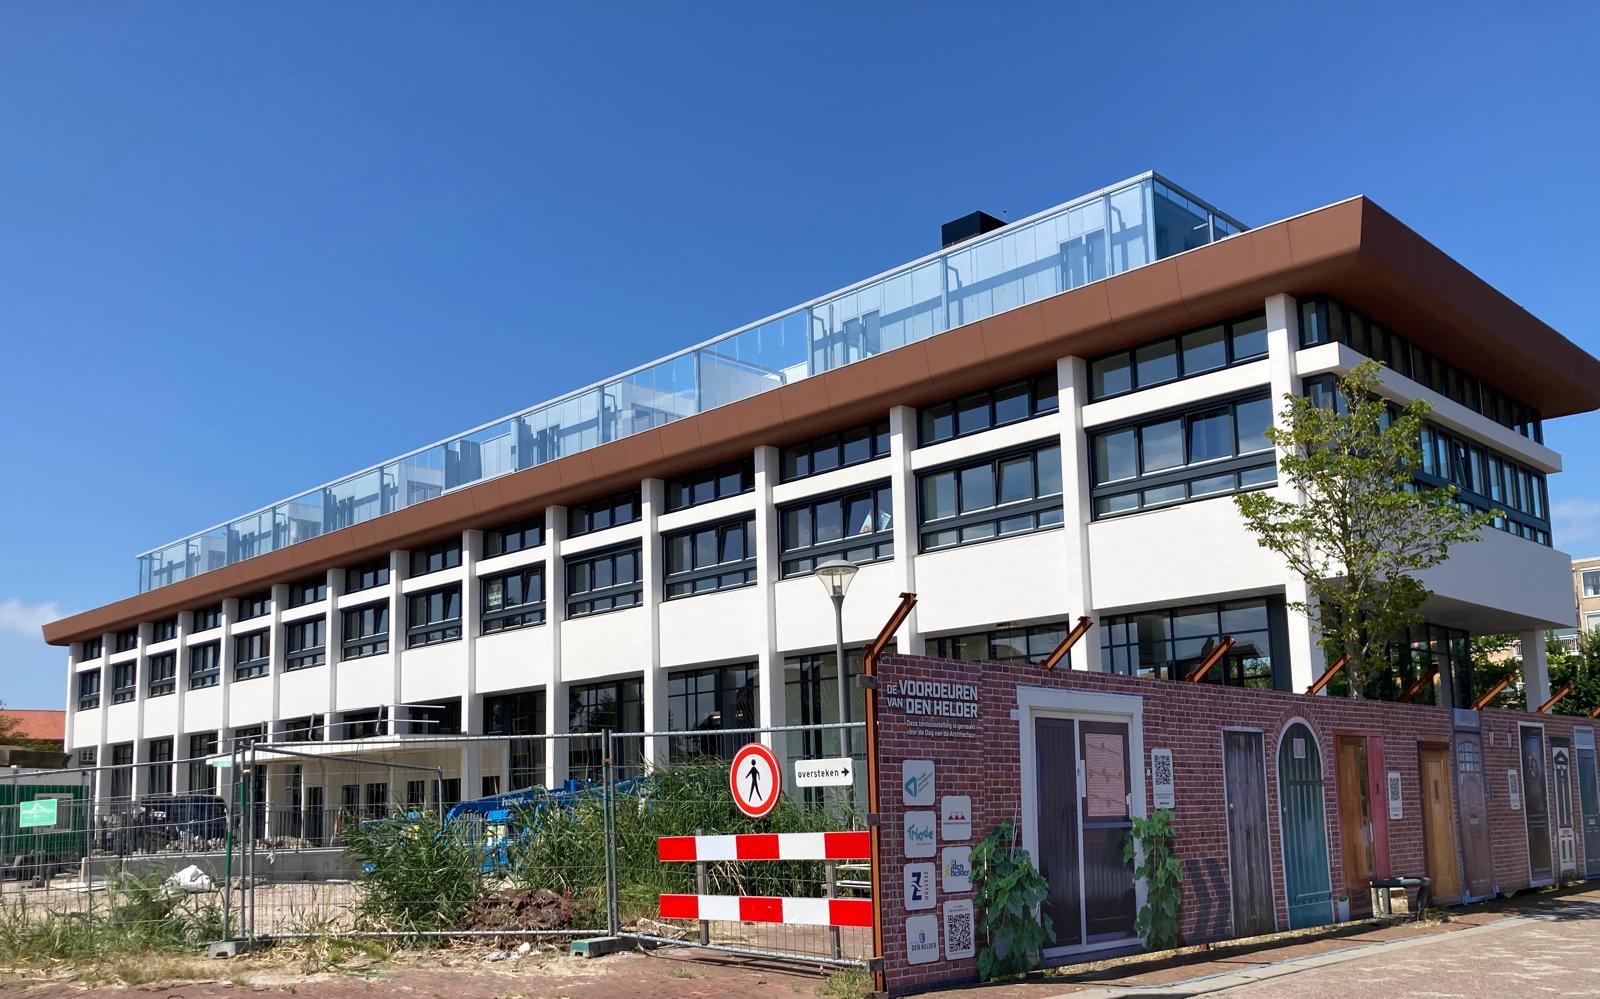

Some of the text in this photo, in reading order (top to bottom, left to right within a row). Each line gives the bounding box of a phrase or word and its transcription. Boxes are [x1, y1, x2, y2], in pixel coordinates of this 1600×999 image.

[887, 680, 978, 700] DE VOORDEUREN
[887, 697, 978, 718] VAN DEN HELDER
[797, 769, 839, 778] oversteken
